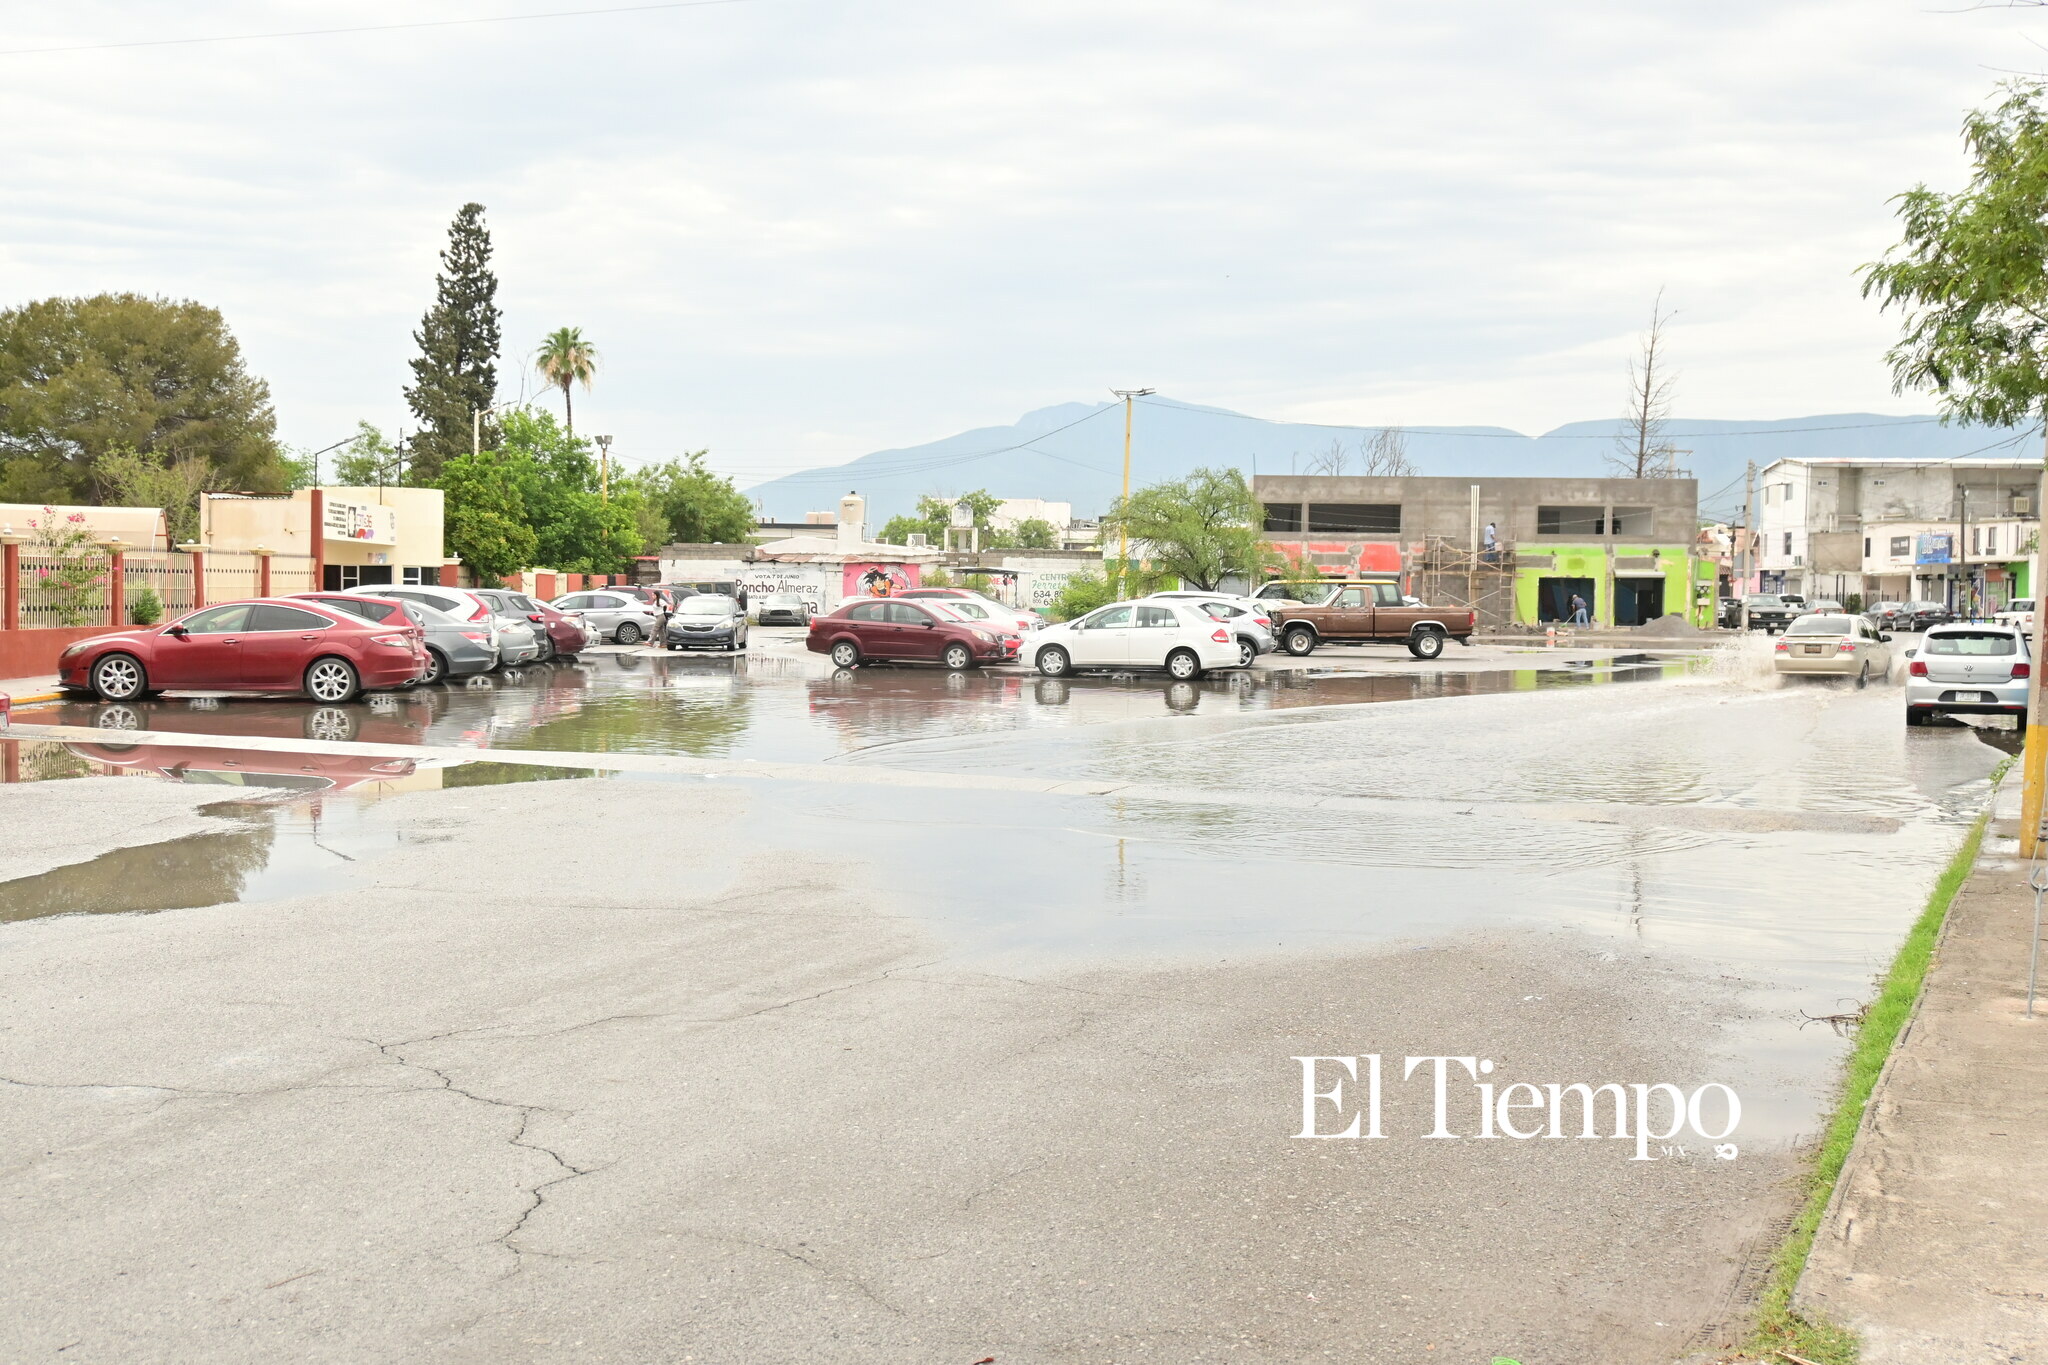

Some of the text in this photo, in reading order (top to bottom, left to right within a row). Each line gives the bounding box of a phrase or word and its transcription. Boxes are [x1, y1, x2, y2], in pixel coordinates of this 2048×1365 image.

[735, 579, 818, 594] Poncho Almeraz
[1033, 590, 1051, 598] 634
